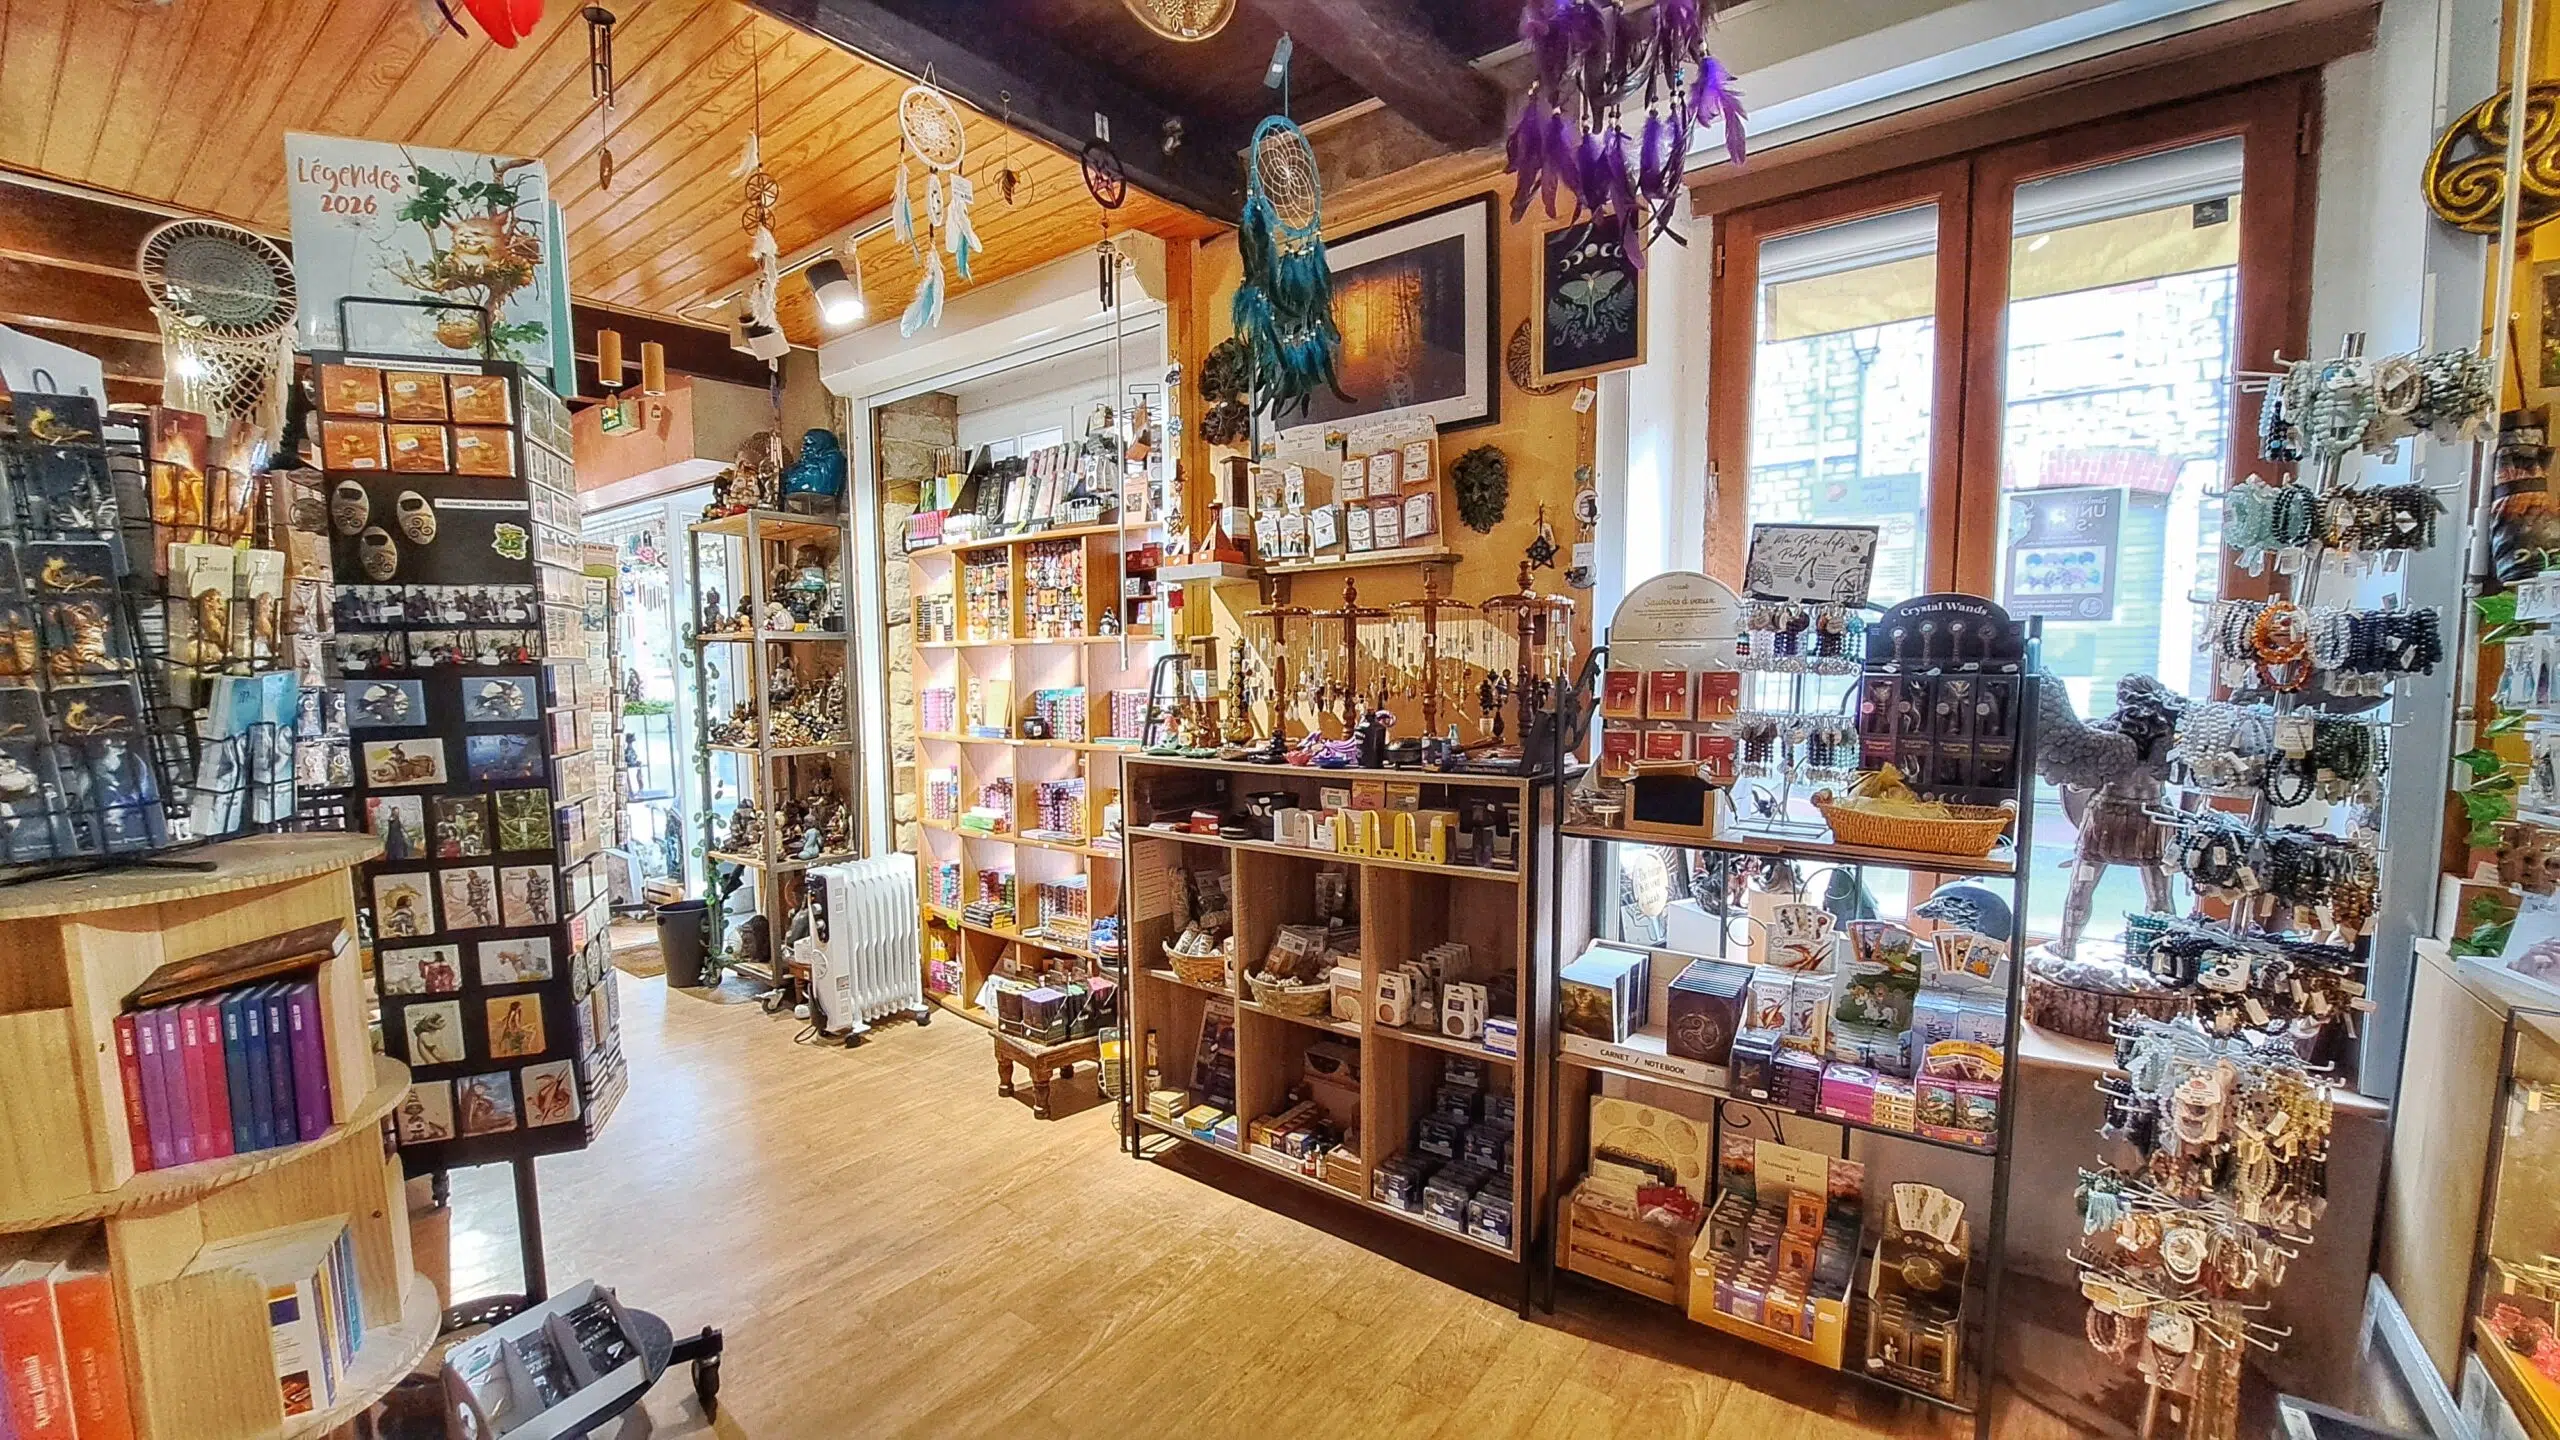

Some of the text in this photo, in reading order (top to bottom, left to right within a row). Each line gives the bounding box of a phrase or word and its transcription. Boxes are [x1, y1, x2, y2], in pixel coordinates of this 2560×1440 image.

[298, 156, 401, 194] Légendes
[320, 194, 377, 214] 2026
[1900, 602, 1989, 617] Crystal Wands
[1600, 1049, 1687, 1075] CARNET / NOTEBOOK
